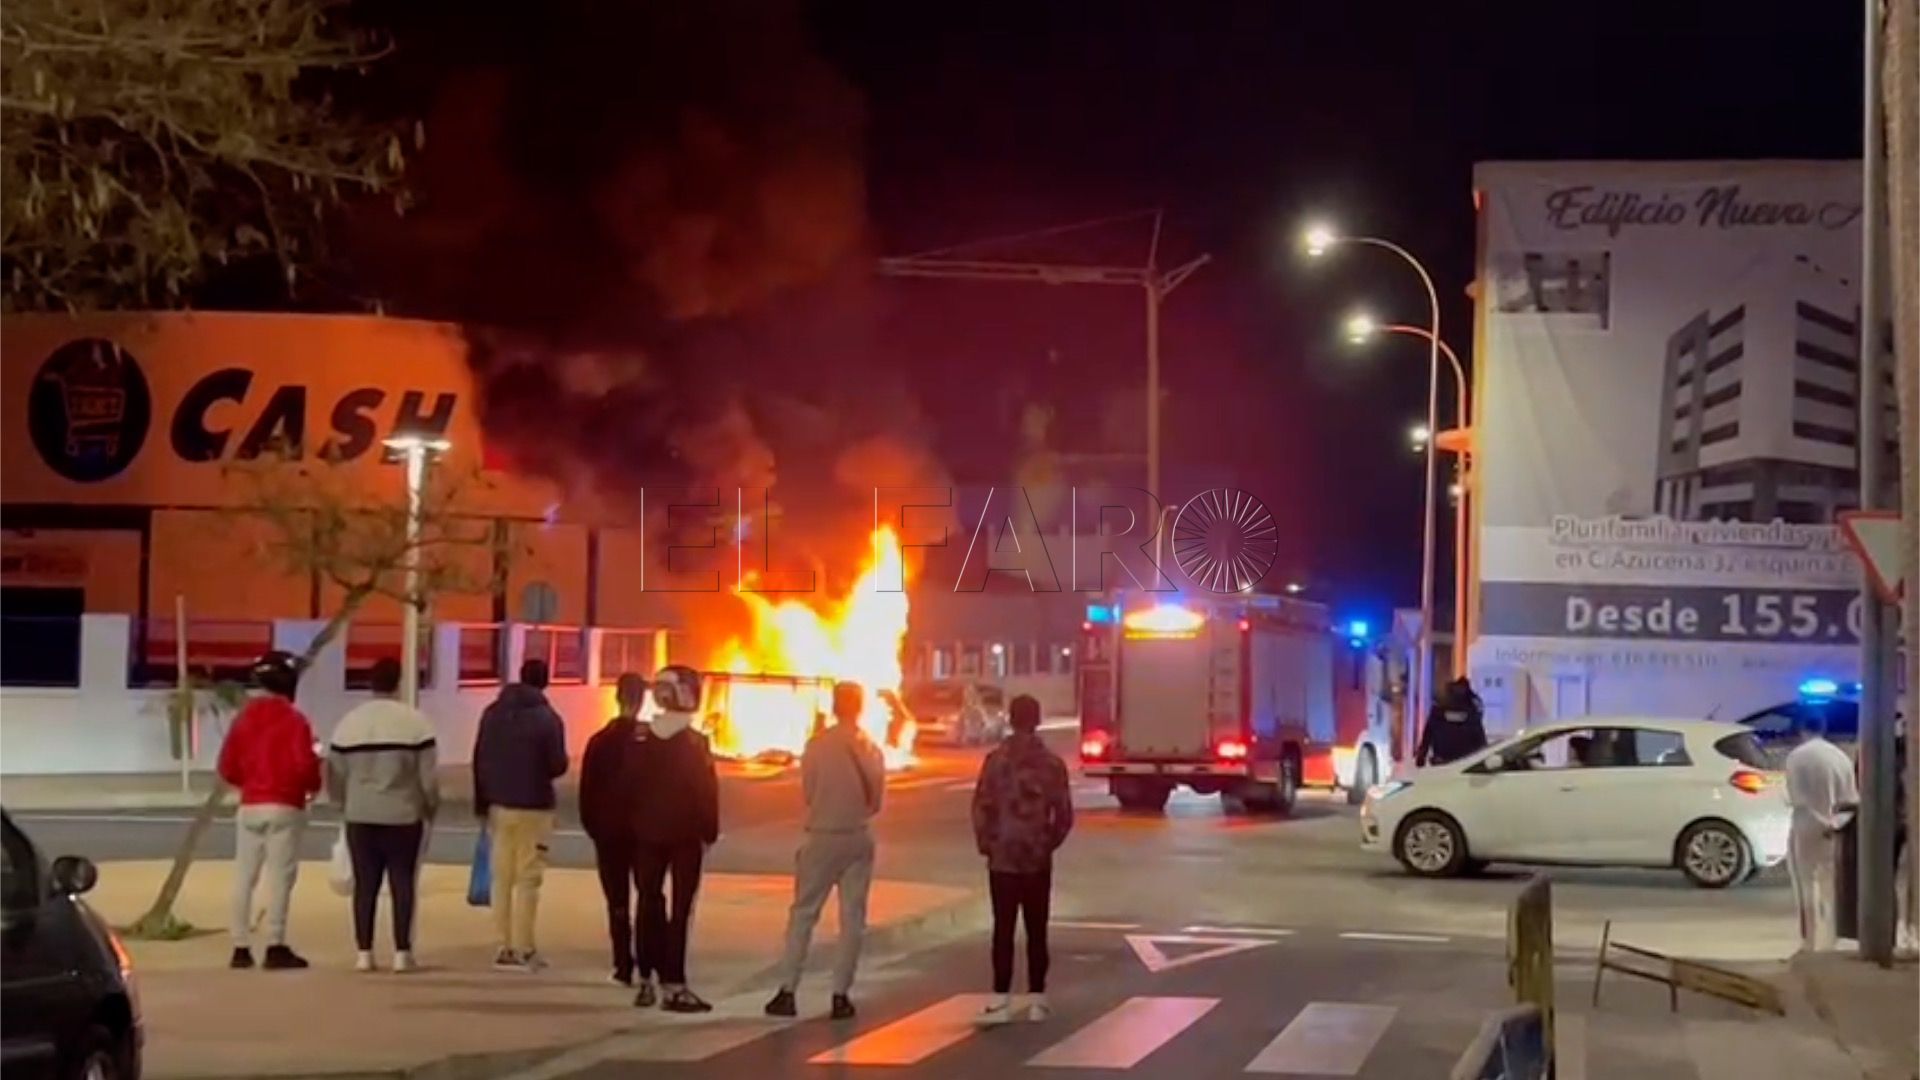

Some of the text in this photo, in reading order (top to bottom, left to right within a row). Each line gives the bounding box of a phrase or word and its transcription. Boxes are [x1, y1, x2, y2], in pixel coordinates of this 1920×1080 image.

[1546, 186, 1686, 238] Edificio
[1696, 185, 1814, 229] Nueva
[170, 367, 457, 464] CASH
[1555, 552, 1582, 568] en
[1565, 597, 1699, 634] Desde
